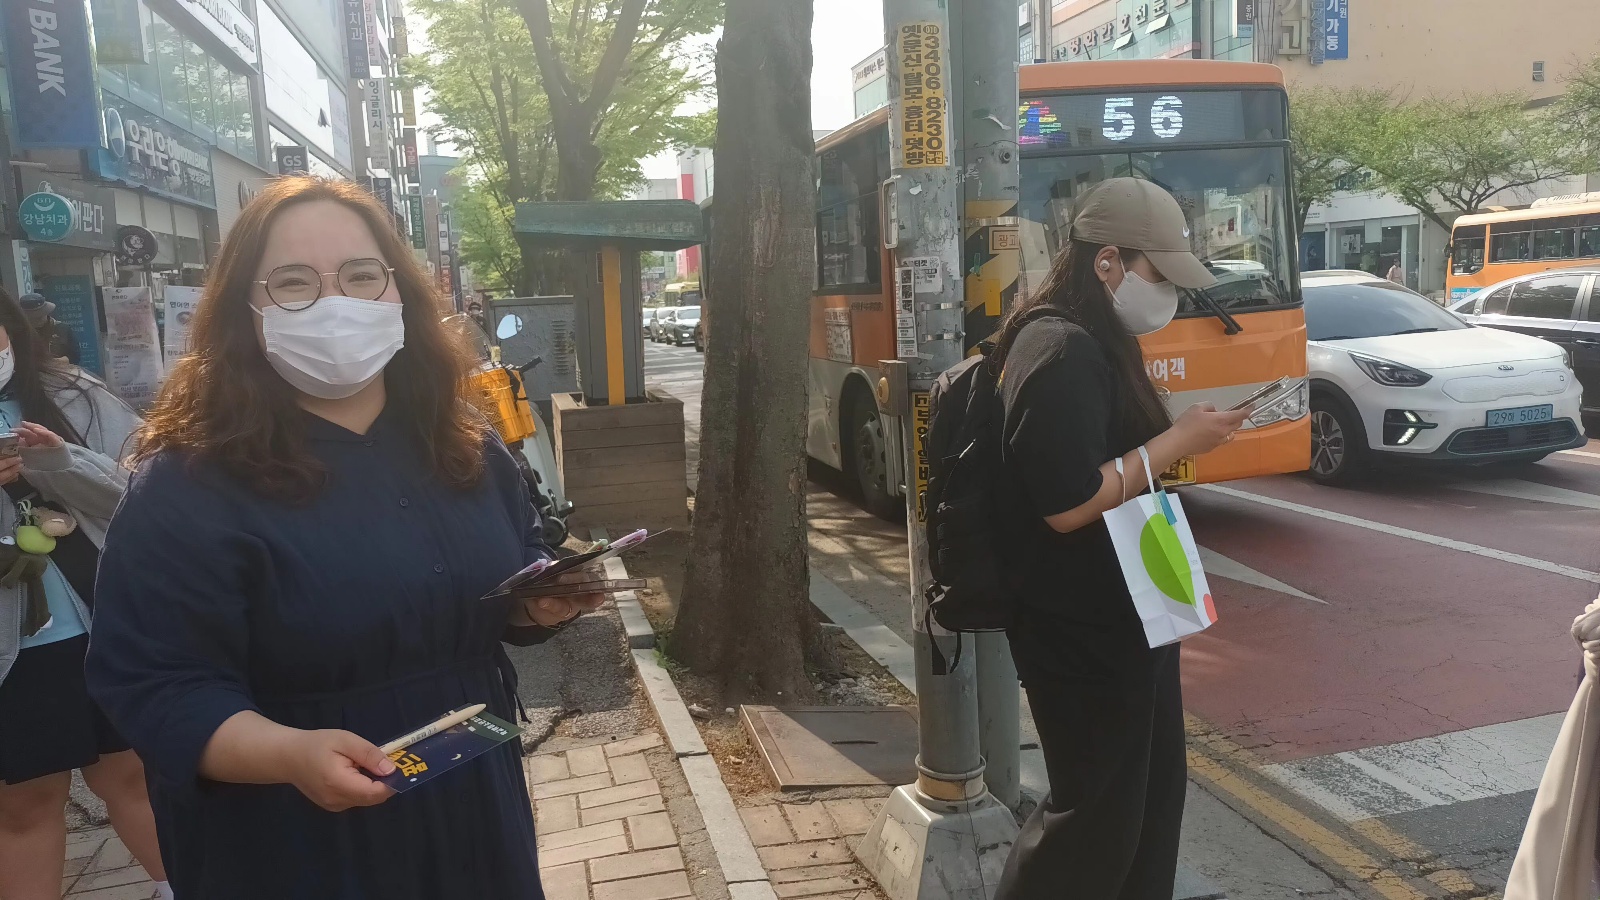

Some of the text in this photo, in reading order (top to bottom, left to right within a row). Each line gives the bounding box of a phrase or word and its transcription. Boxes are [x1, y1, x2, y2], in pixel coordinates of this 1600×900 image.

[28, 8, 66, 97] BANK
[368, 80, 383, 131] 잉글리시
[125, 119, 181, 177] 우리은행
[283, 156, 302, 167] GS
[24, 213, 68, 226] 강남치과
[70, 199, 104, 235] 어판다
[1146, 357, 1186, 382] 여객
[1520, 407, 1547, 422] 5025
